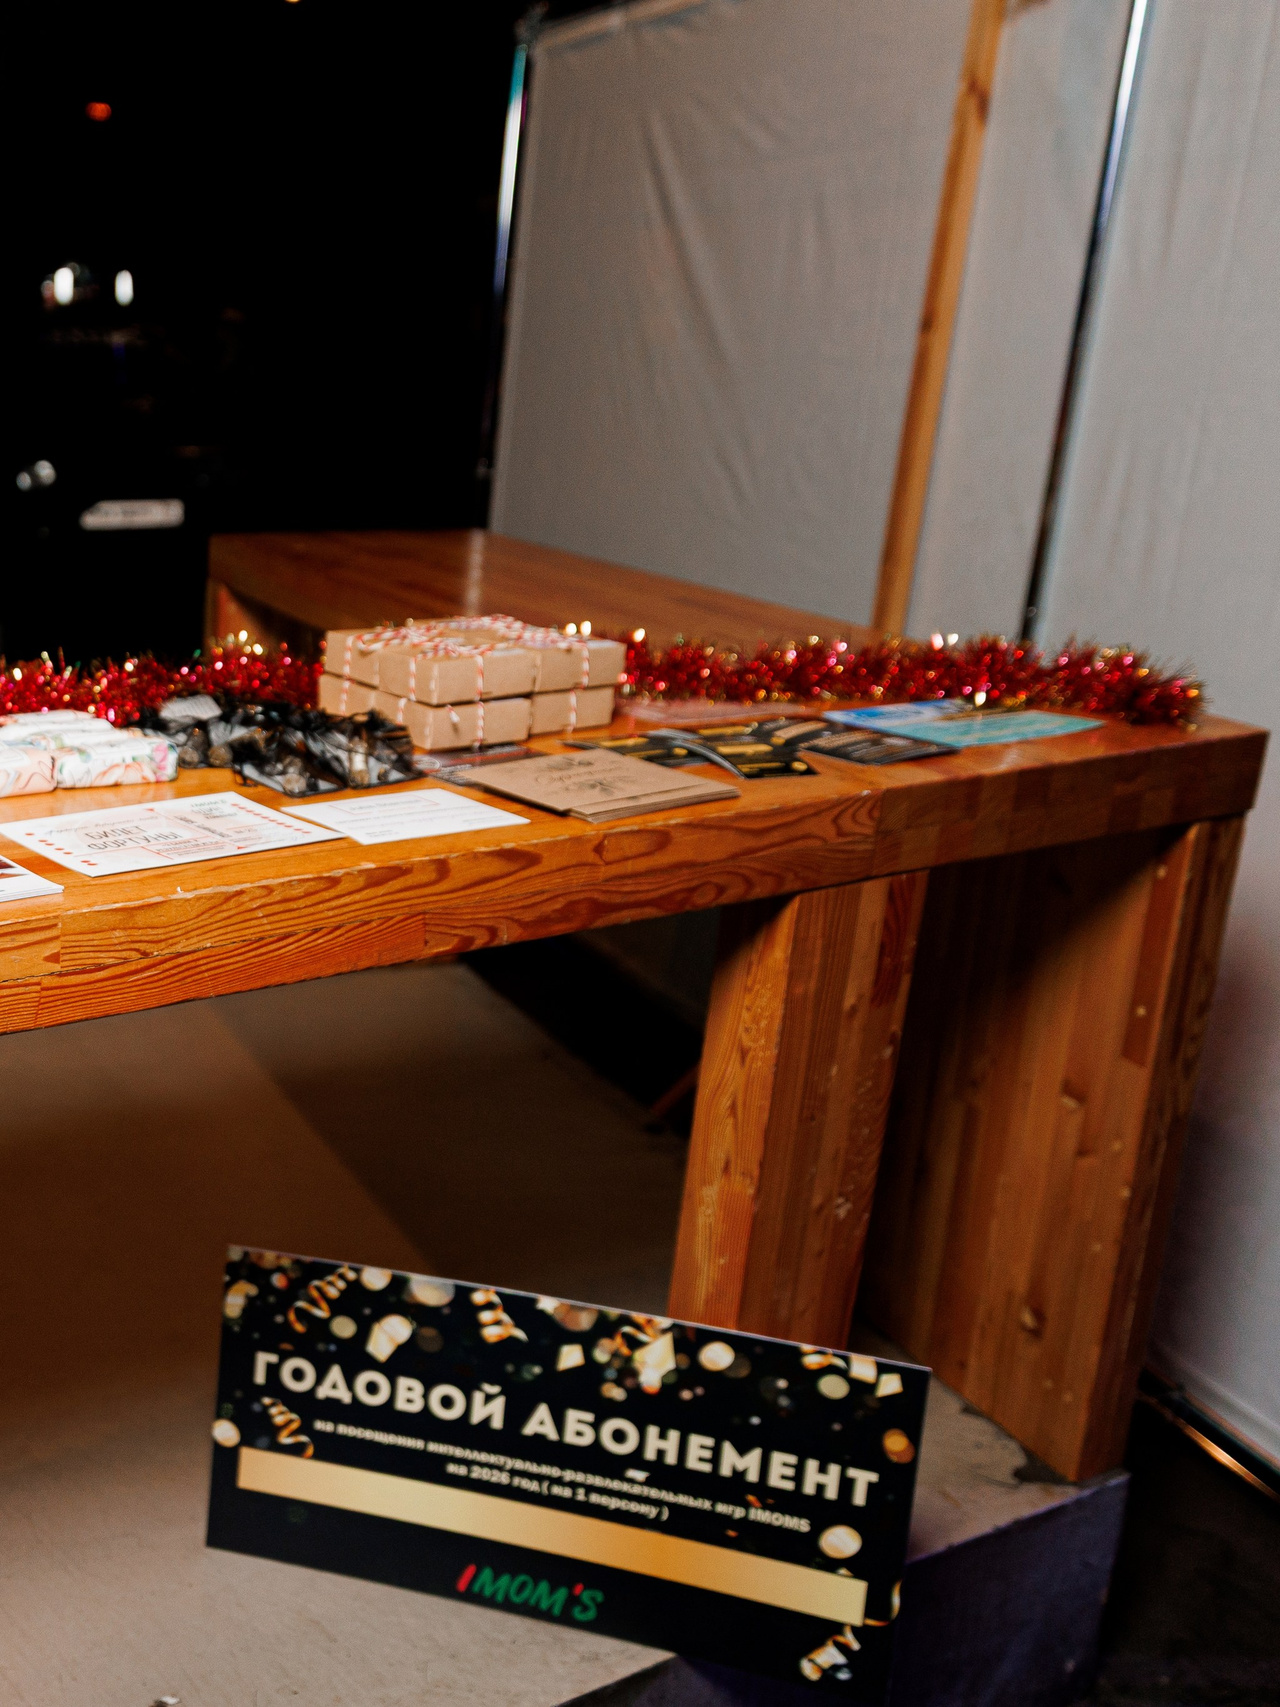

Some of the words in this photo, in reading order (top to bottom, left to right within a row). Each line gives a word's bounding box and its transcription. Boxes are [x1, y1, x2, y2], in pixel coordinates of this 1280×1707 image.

[84, 825, 148, 840] БИЛЕТ
[252, 1350, 506, 1430] ГОДОВОЙ
[521, 1402, 880, 1507] АБОНЕМЕНТ
[336, 1422, 426, 1450] посещения
[714, 1501, 746, 1519] игр
[445, 1462, 468, 1476] на
[470, 1464, 511, 1486] 2026
[512, 1475, 541, 1493] год
[456, 1563, 605, 1622] IMOM'S
